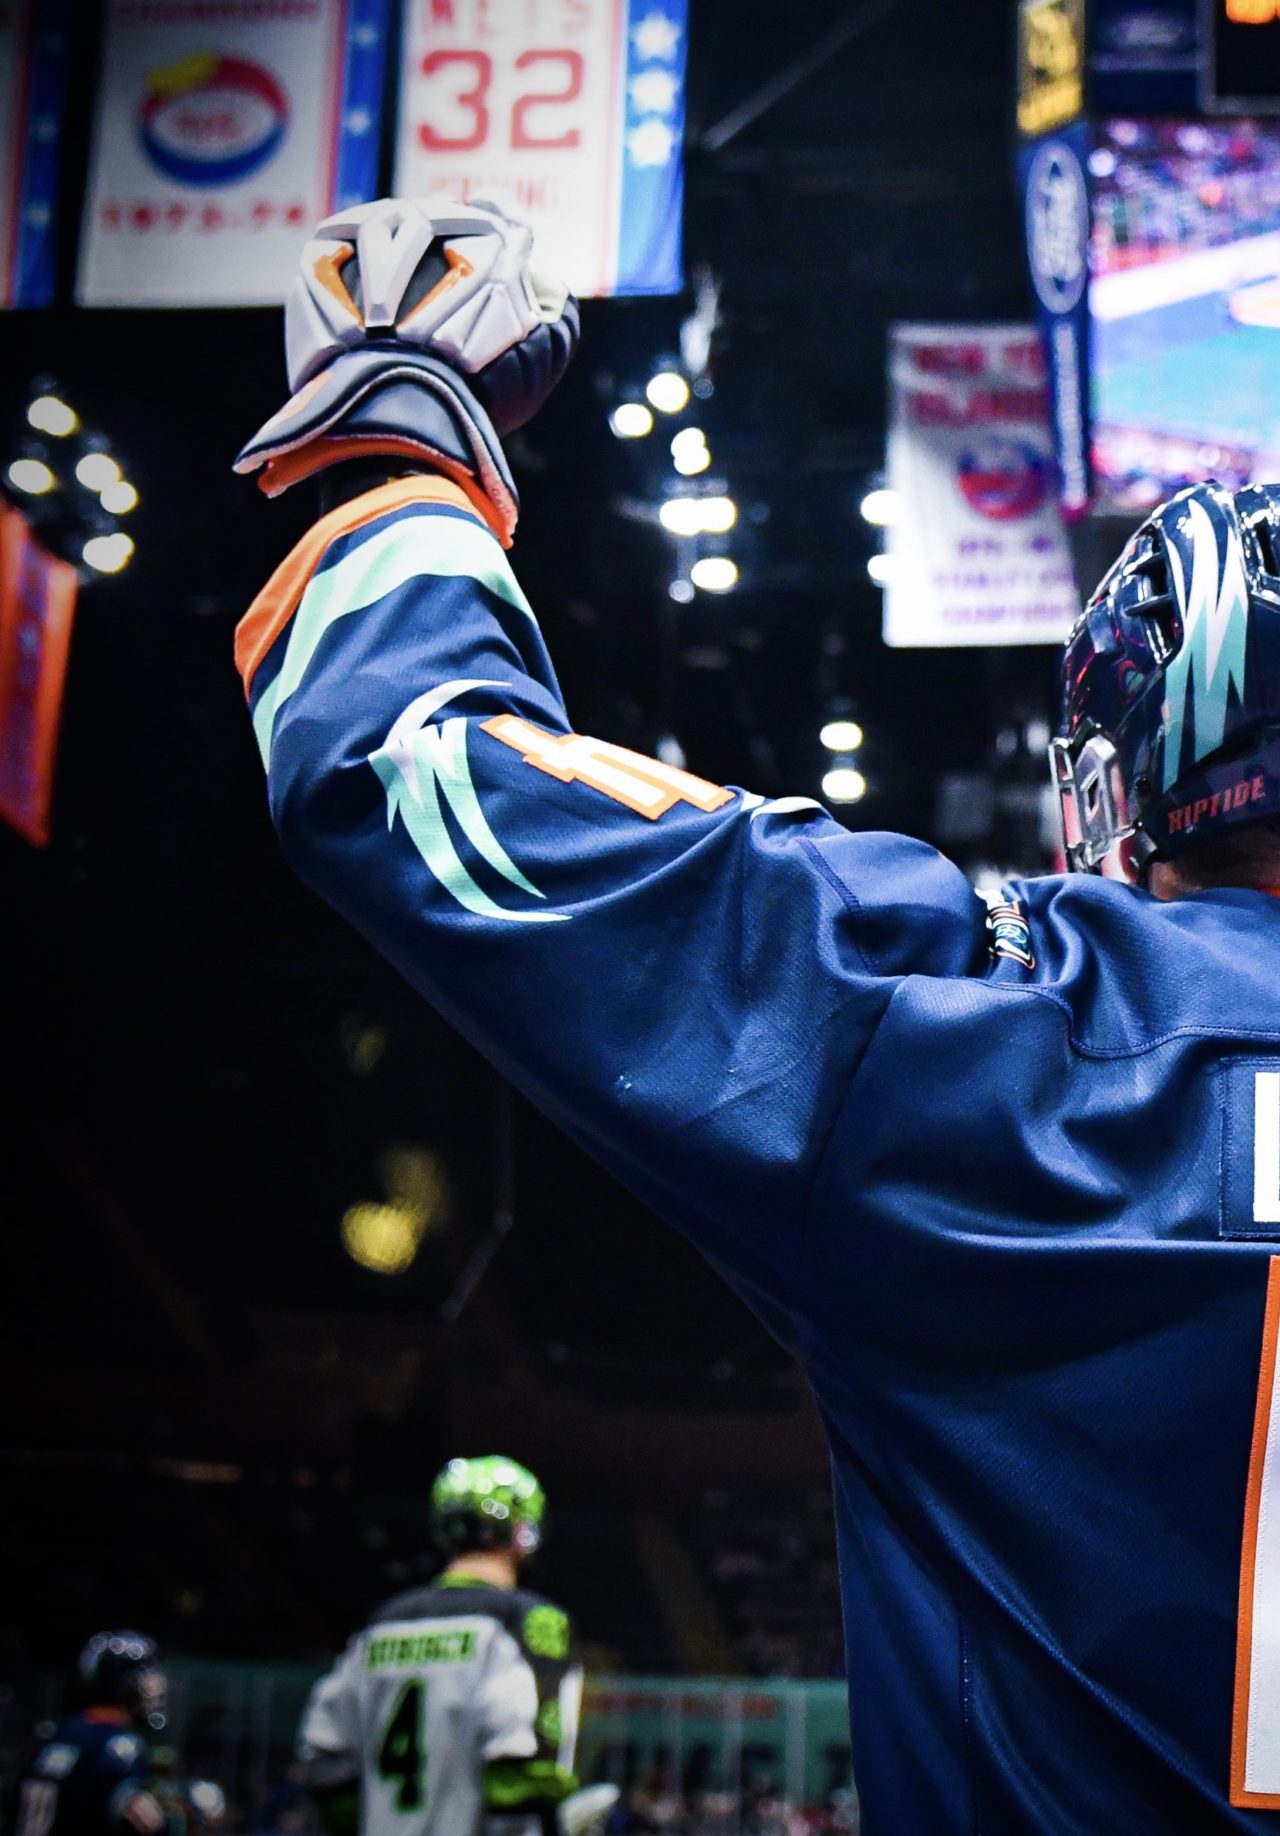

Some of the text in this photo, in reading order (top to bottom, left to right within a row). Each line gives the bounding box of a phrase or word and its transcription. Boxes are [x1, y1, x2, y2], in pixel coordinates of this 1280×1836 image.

[418, 49, 585, 152] 32
[1168, 775, 1266, 834] RIPTIDE
[378, 1676, 428, 1816] 4
